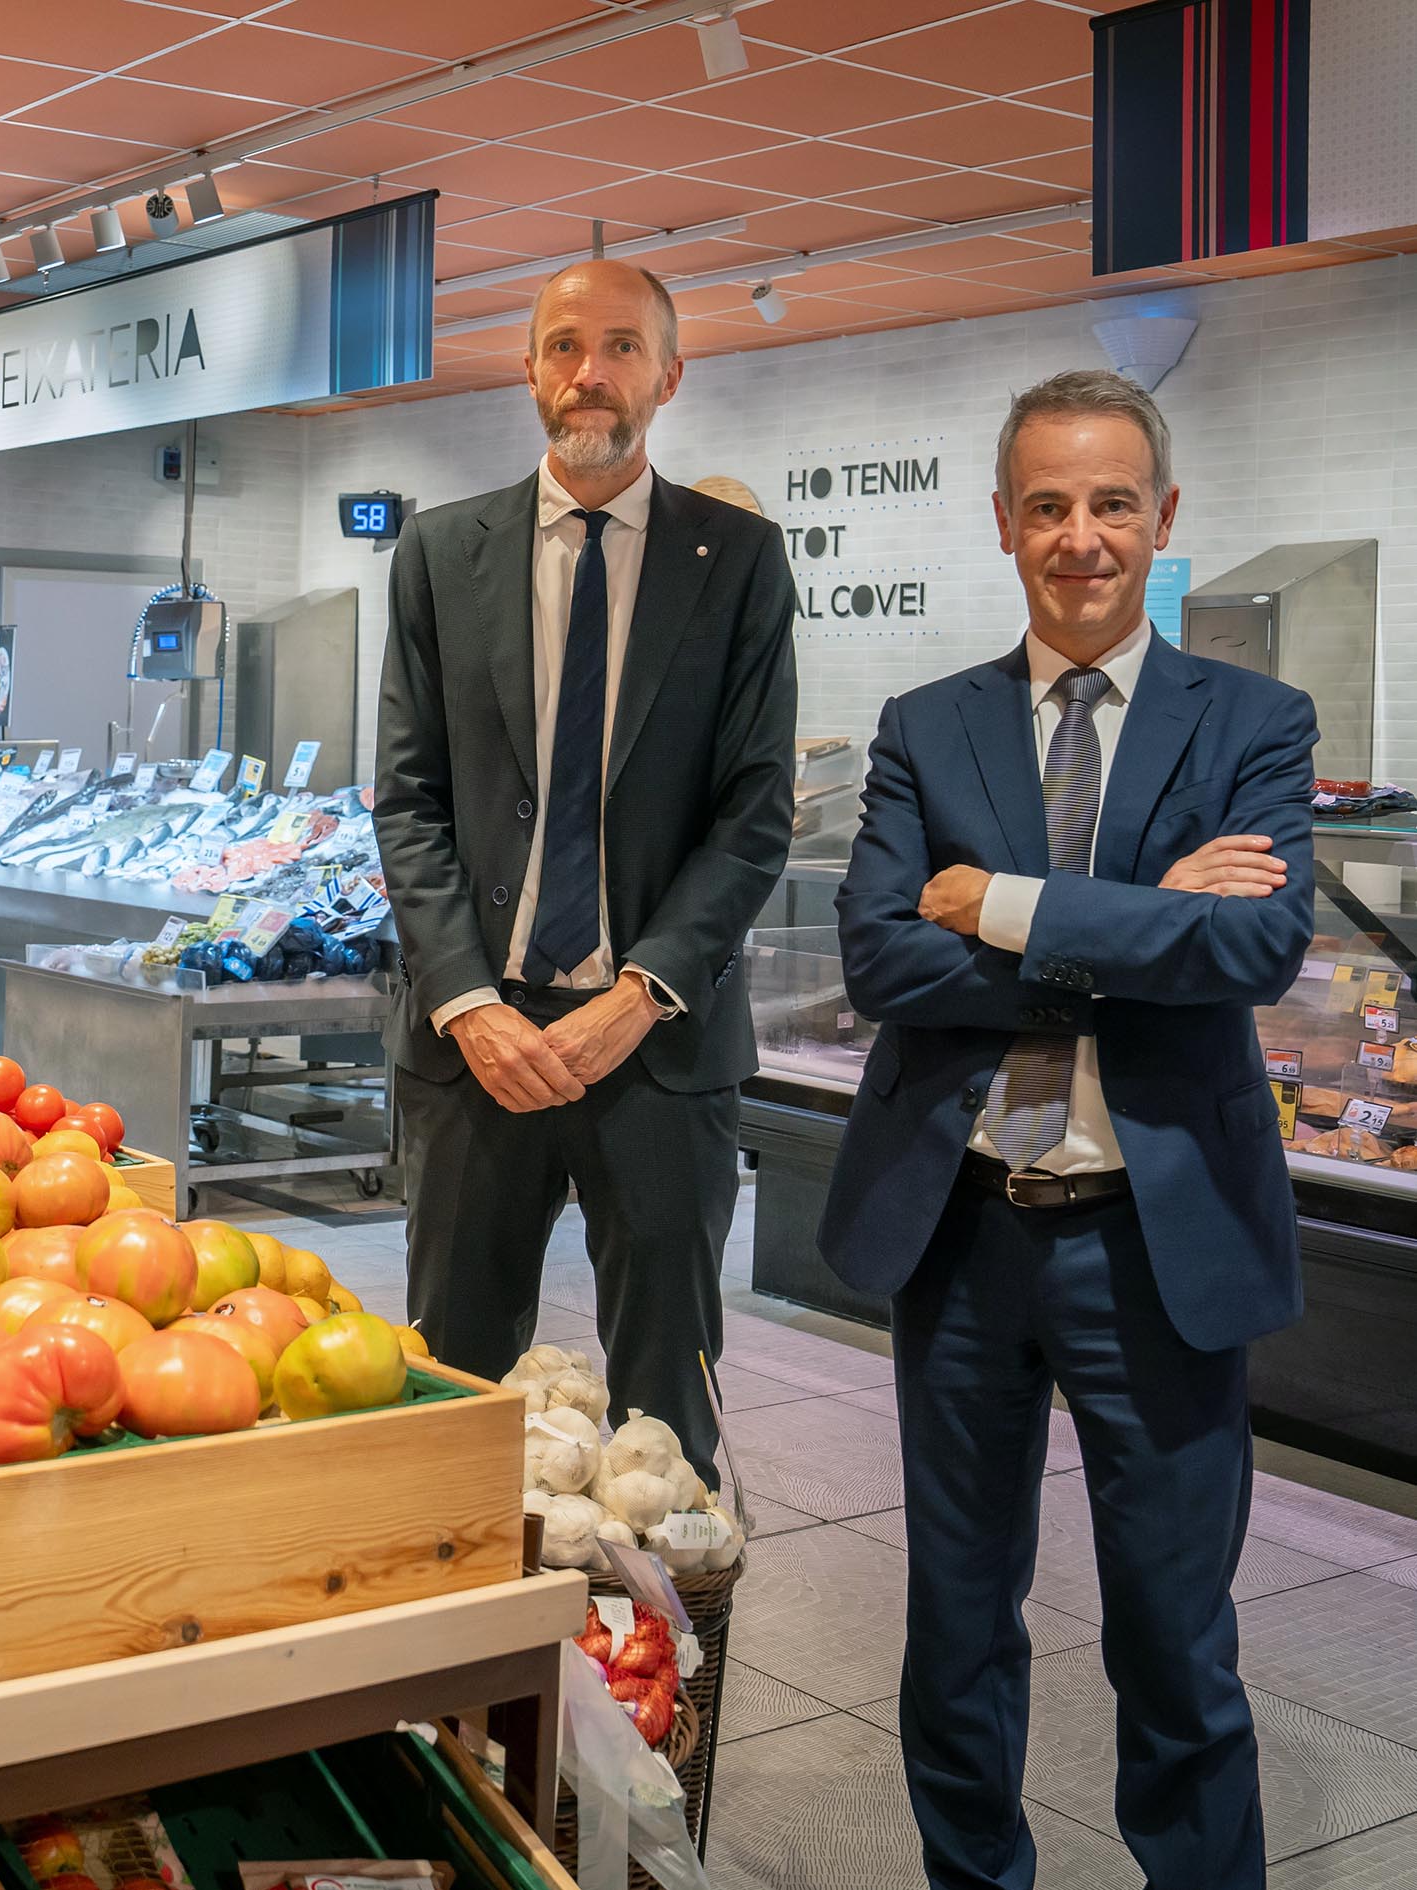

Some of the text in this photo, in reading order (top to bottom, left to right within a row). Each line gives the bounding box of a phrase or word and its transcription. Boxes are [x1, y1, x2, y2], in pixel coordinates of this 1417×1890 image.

[787, 457, 938, 502] HO TENIM
[353, 503, 386, 531] 58
[786, 525, 846, 560] TOT
[831, 582, 926, 618] COVE!
